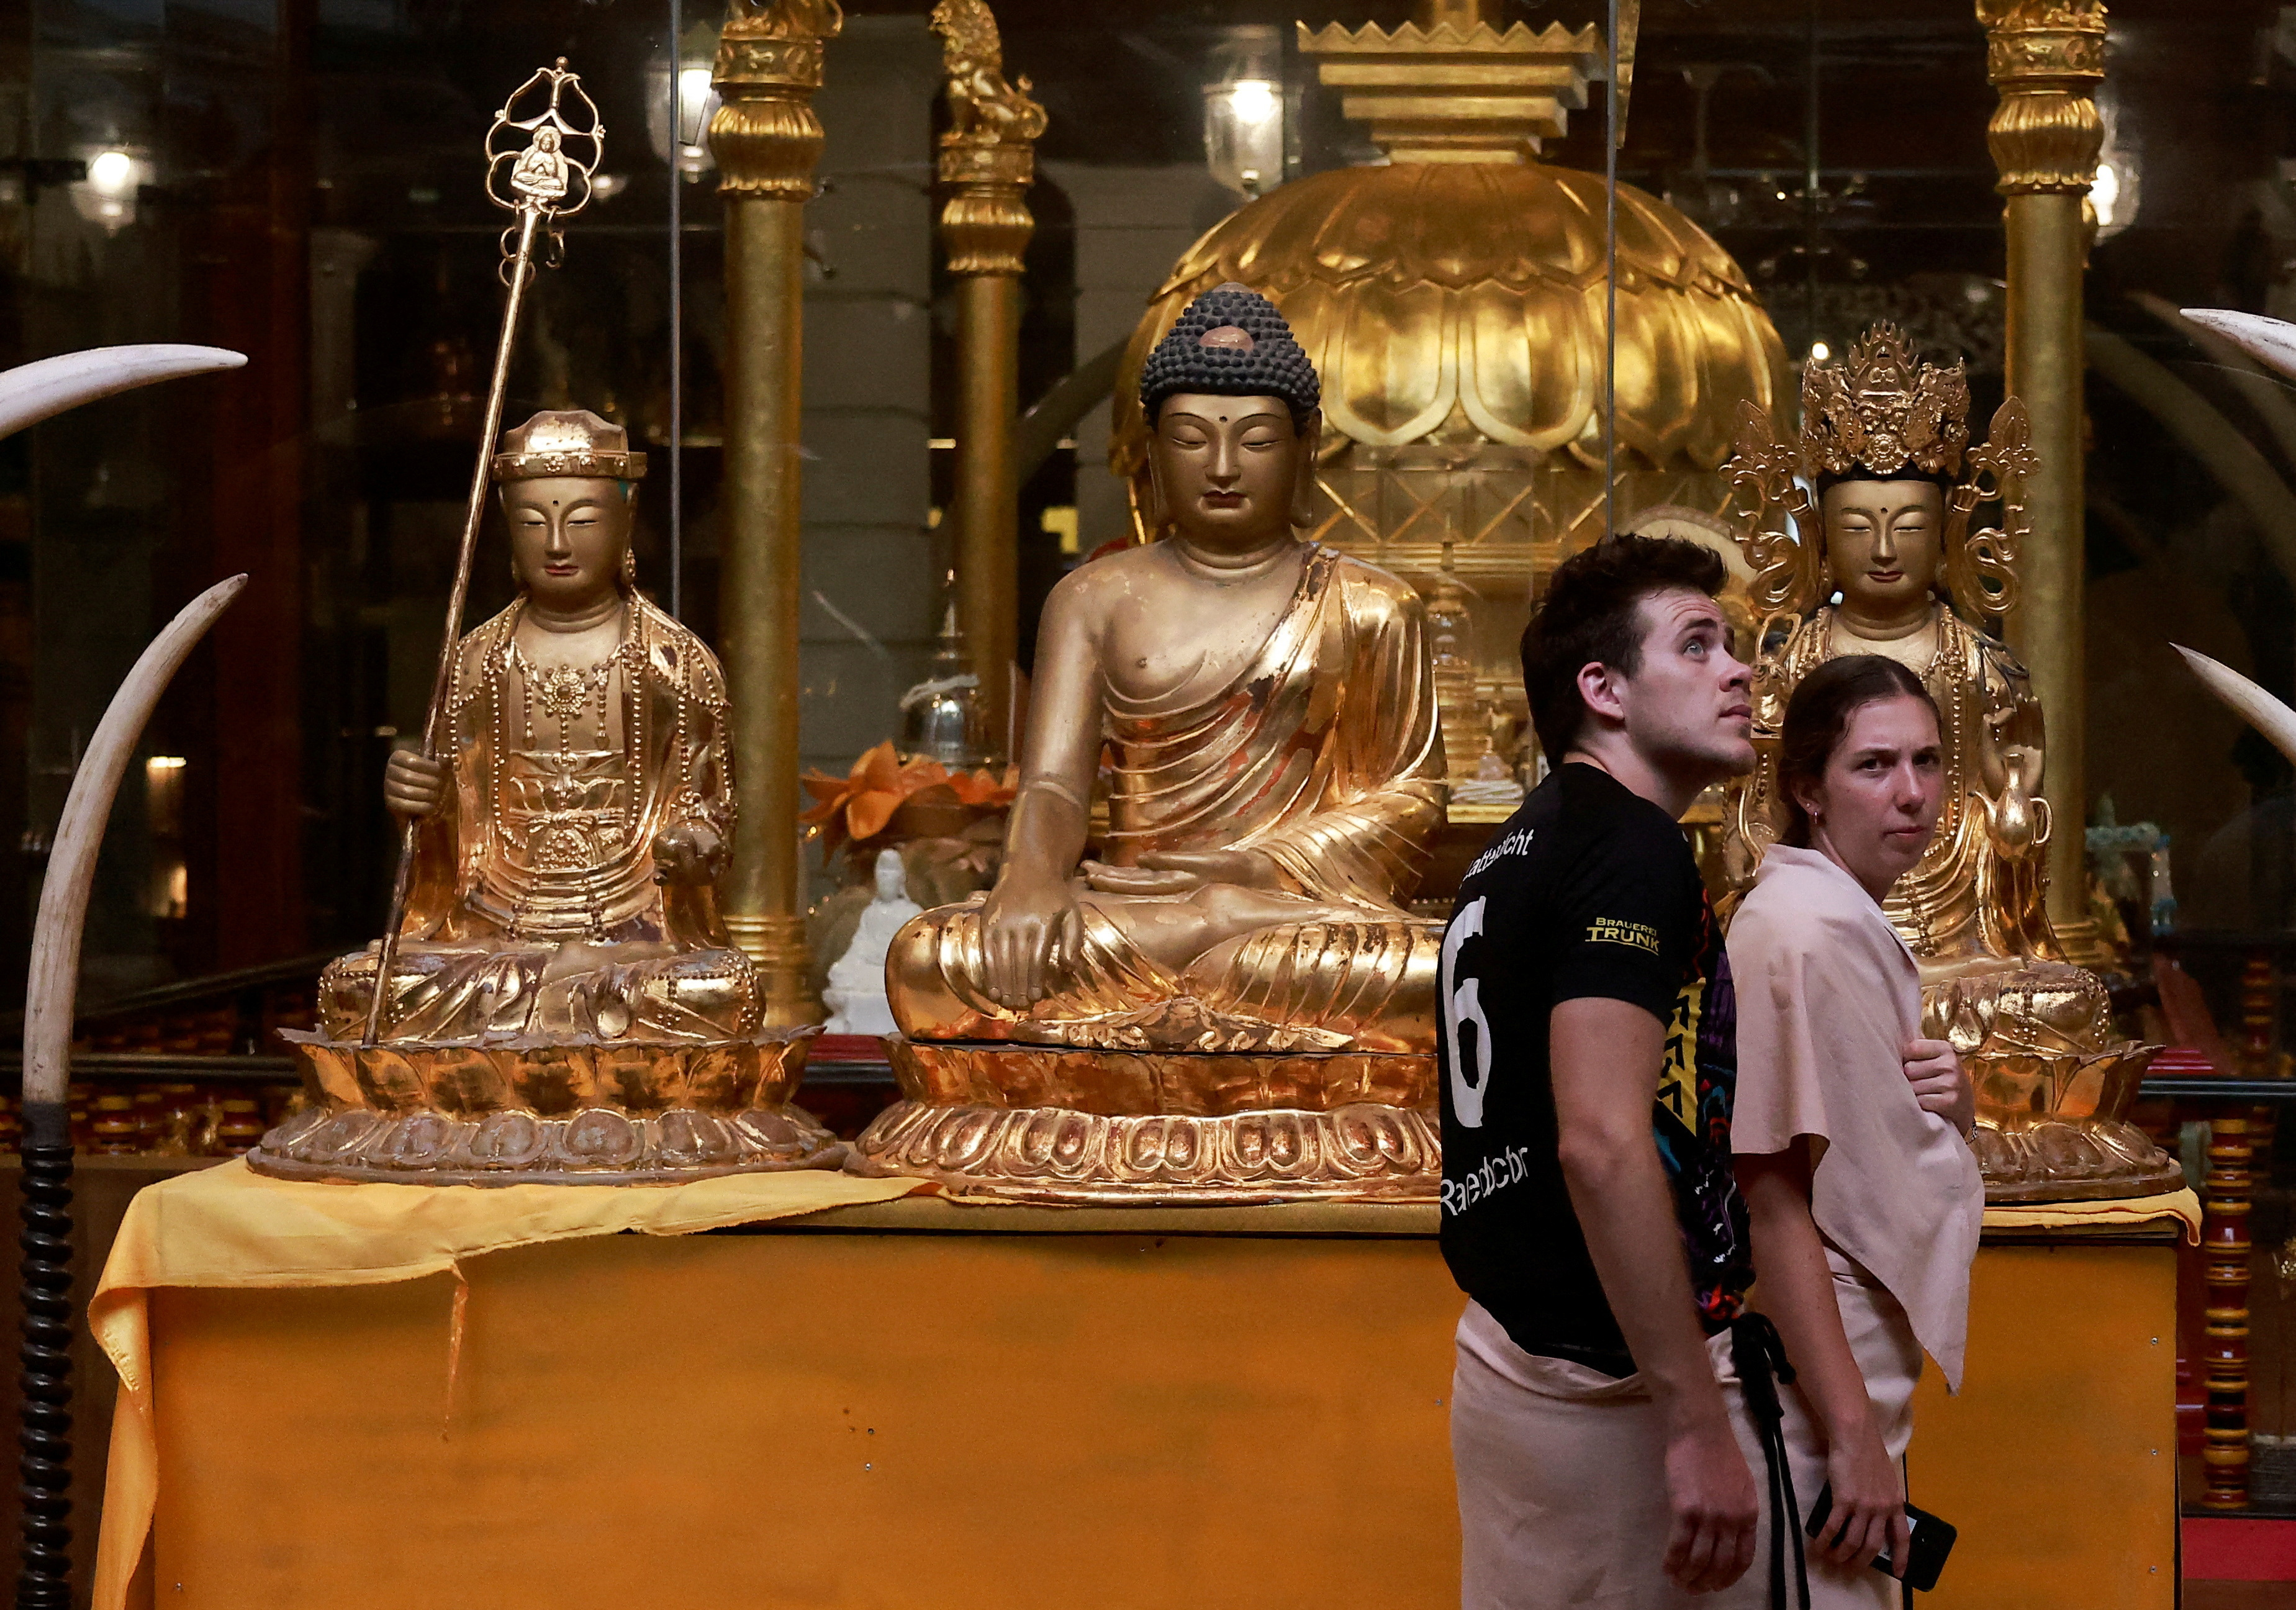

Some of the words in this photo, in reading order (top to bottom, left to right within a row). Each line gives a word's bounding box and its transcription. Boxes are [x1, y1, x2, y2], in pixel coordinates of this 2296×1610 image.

[1586, 926, 1660, 952] TRUNK
[1595, 916, 1657, 937] BRAUEREI
[1442, 895, 1491, 1128] 6
